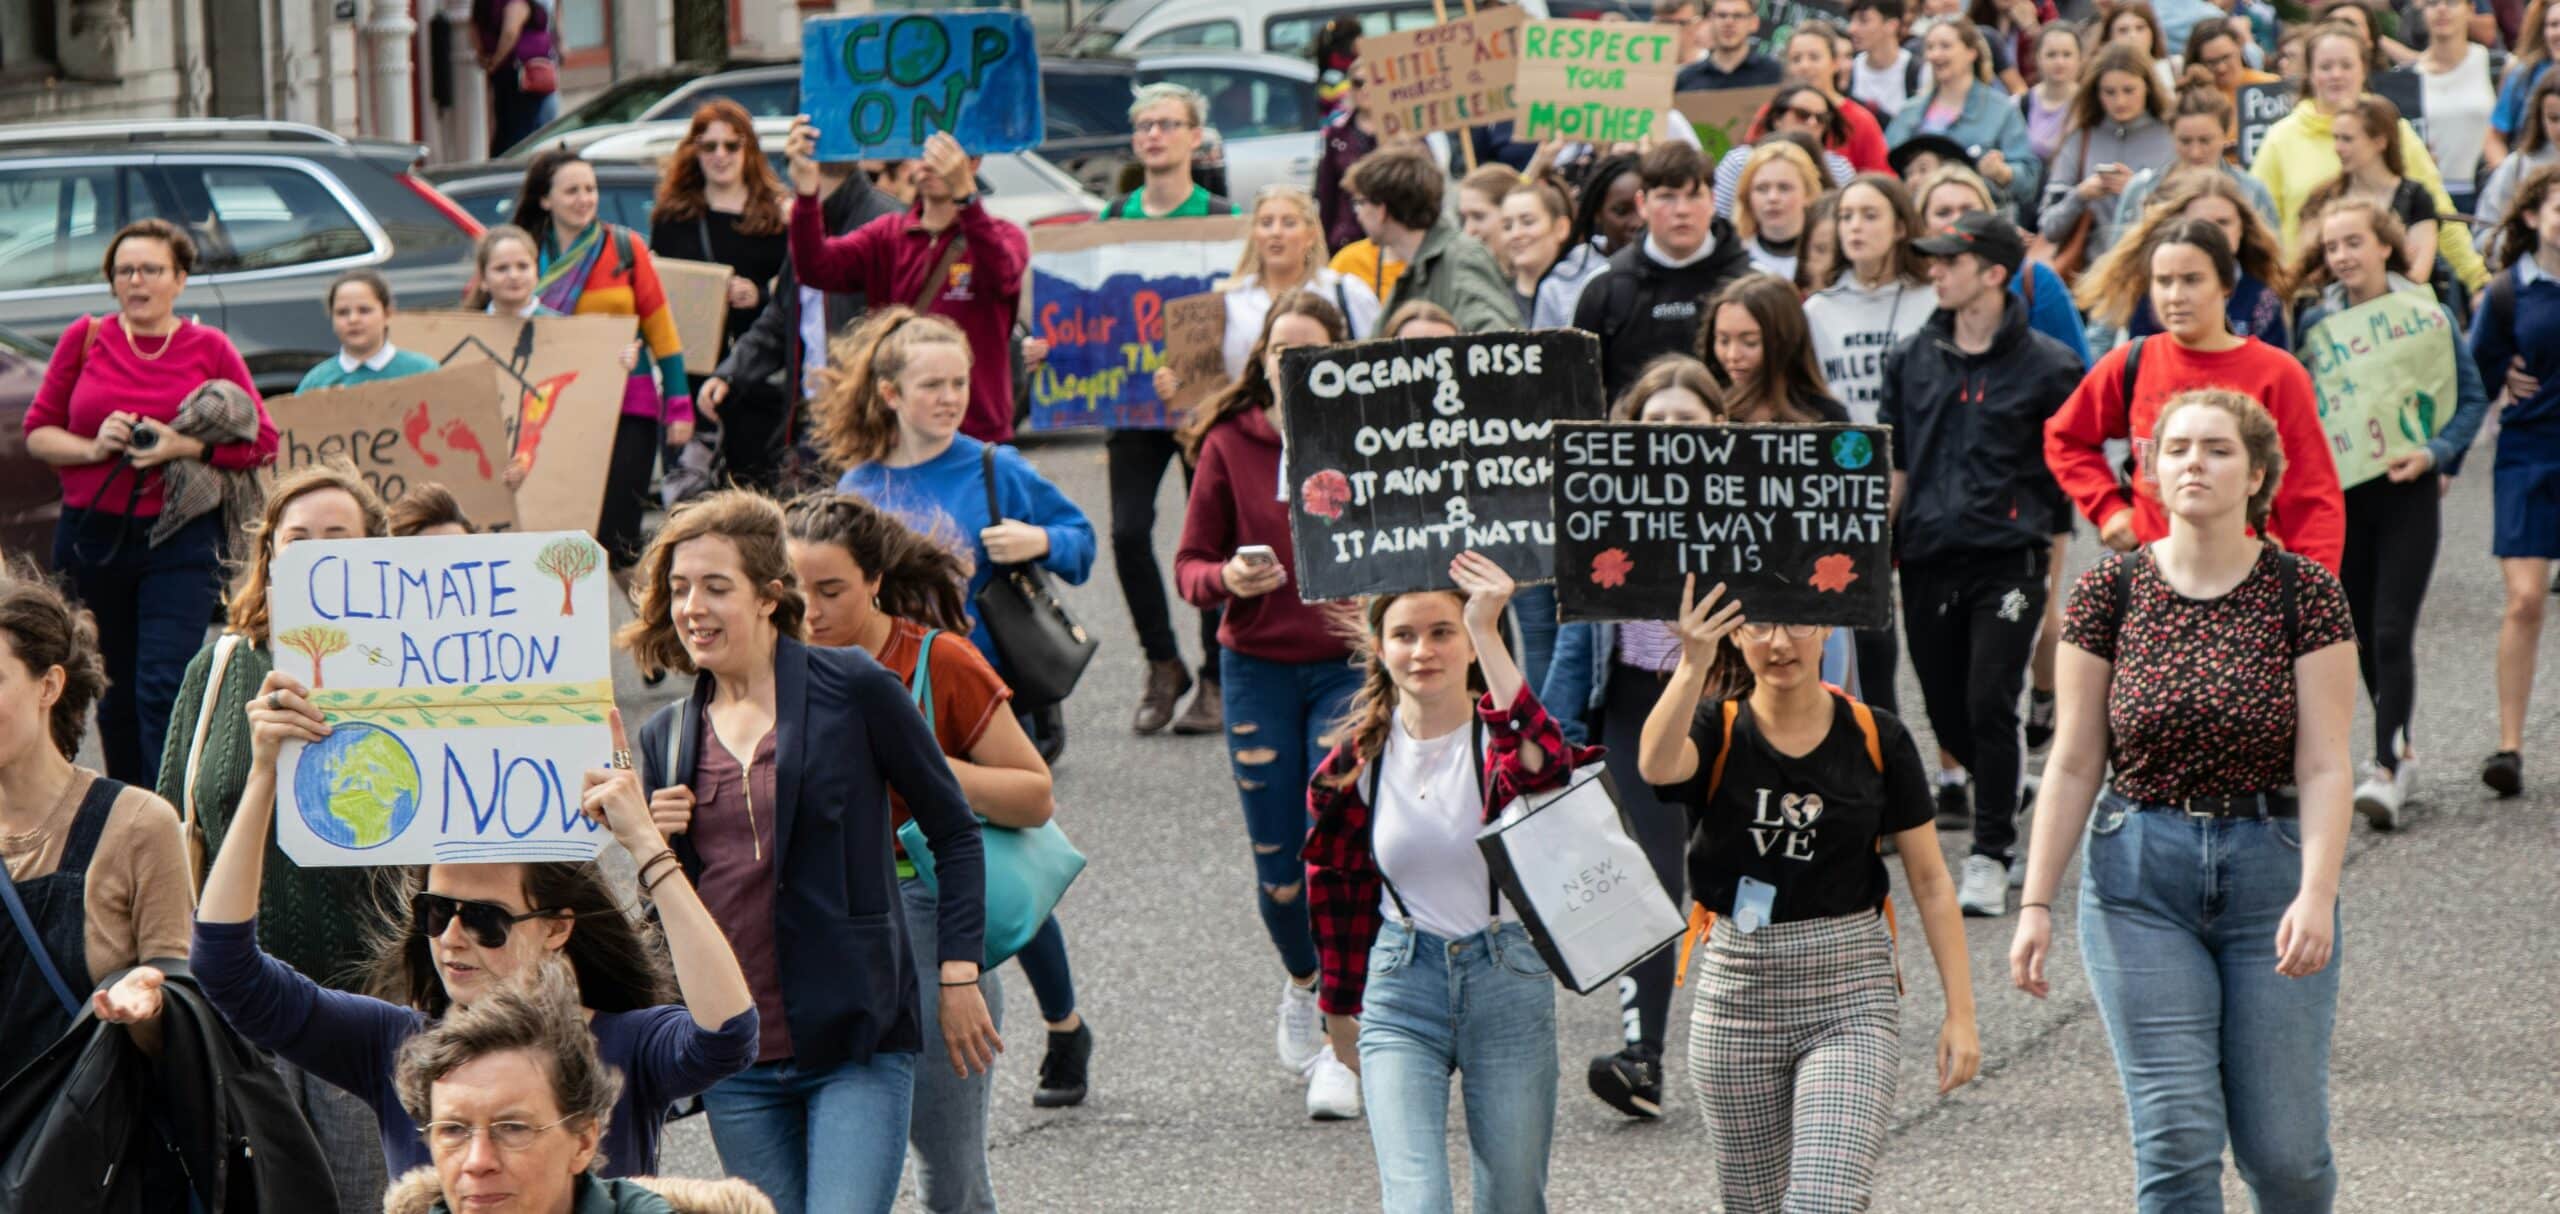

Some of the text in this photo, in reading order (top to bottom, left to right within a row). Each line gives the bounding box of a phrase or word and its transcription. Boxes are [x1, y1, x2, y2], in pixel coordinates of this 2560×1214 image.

[842, 14, 1008, 91] COP
[1370, 26, 1518, 86] LITTLE ACT
[1525, 25, 1672, 63] RESPECT
[1564, 65, 1626, 91] YOUR
[850, 69, 968, 147] ON
[1527, 102, 1656, 142] MOTHER
[1040, 301, 1118, 348] Solar
[1308, 344, 1543, 398] OCEANS RISE
[1432, 379, 1466, 416] &
[1354, 418, 1552, 457] OVERFLOW
[1563, 432, 1819, 467] SEE HOW THE
[1350, 471, 1378, 506] IT
[1383, 460, 1469, 496] AIN'T
[1563, 472, 1886, 510] COULD BE IN SPITE
[1445, 495, 1476, 529] &
[1566, 511, 1886, 544] OF THE WAY THAT
[1331, 530, 1365, 563] IT
[1678, 543, 1763, 574] IT IS
[308, 555, 518, 621] CLIMATE
[398, 629, 560, 688] ACTION
[1562, 856, 1614, 895] NEW
[1565, 869, 1628, 912] LOOK
